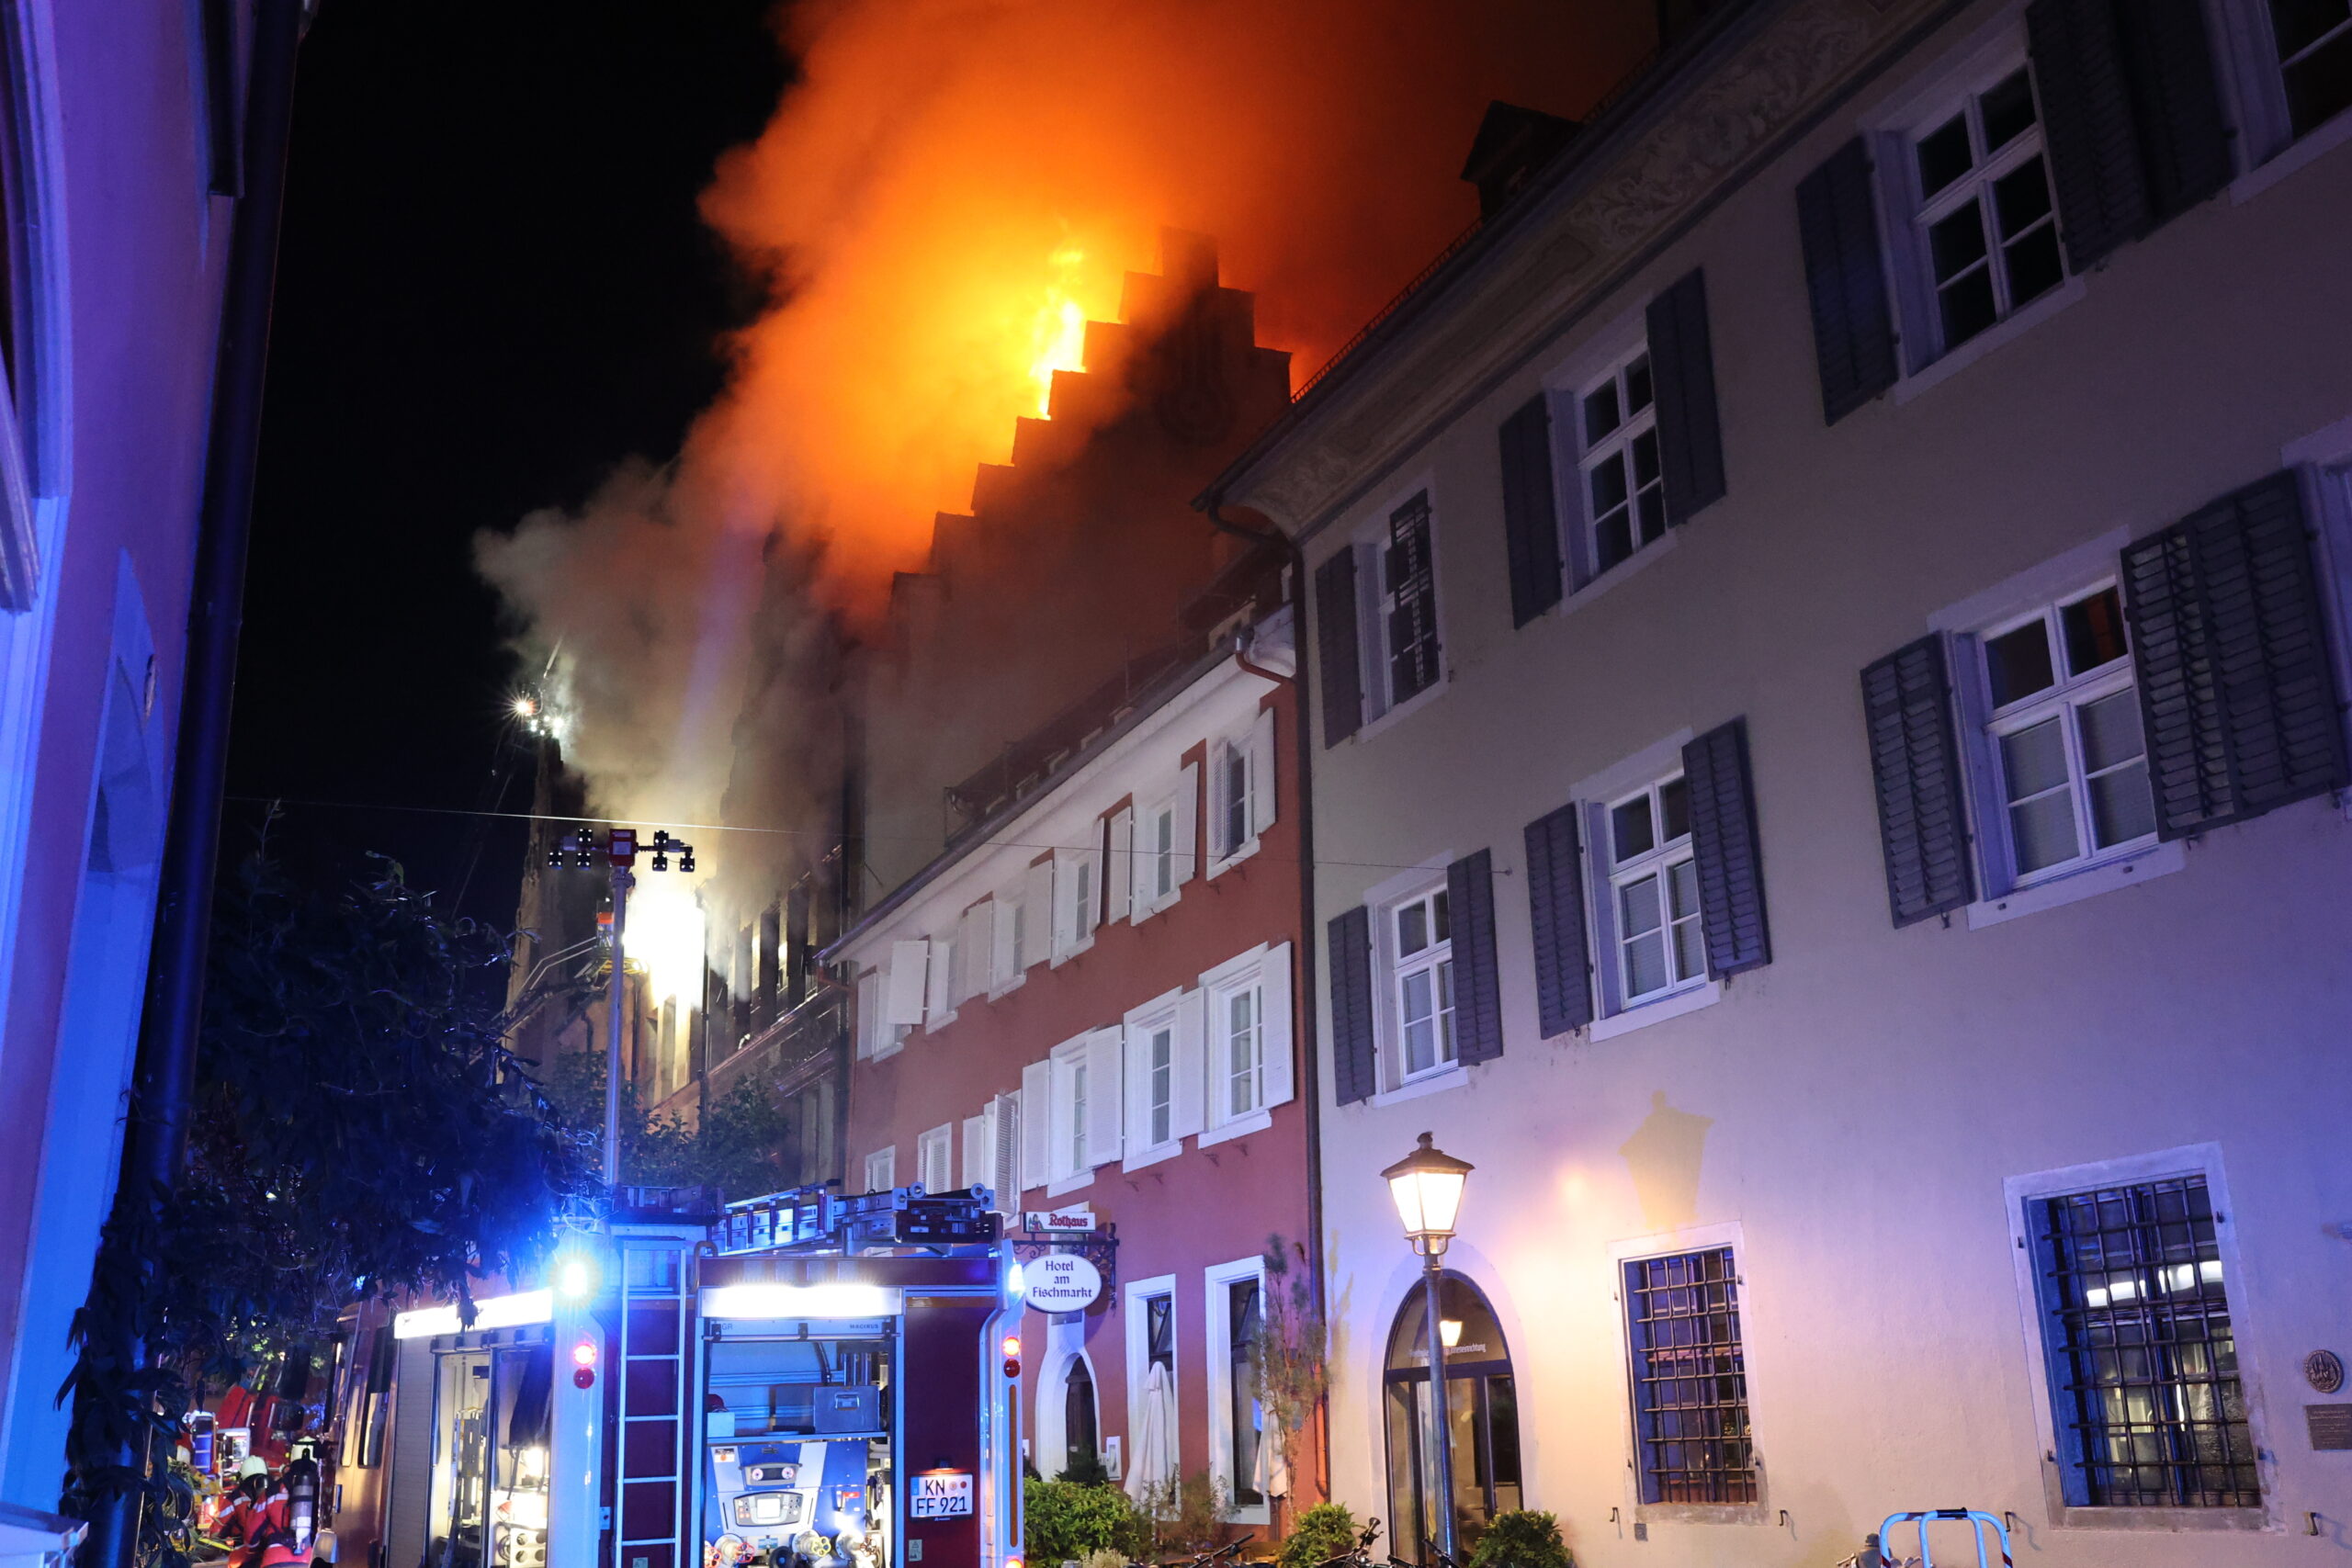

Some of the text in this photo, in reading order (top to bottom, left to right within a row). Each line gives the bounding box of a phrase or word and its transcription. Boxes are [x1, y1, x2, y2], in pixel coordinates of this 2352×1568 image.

[1048, 1213, 1089, 1229] Rothaus
[1046, 1260, 1074, 1271] Hotel
[1054, 1275, 1070, 1284] am
[1033, 1287, 1092, 1298] Fischmarkt
[925, 1479, 945, 1495] KN
[916, 1495, 967, 1514] FF 921
